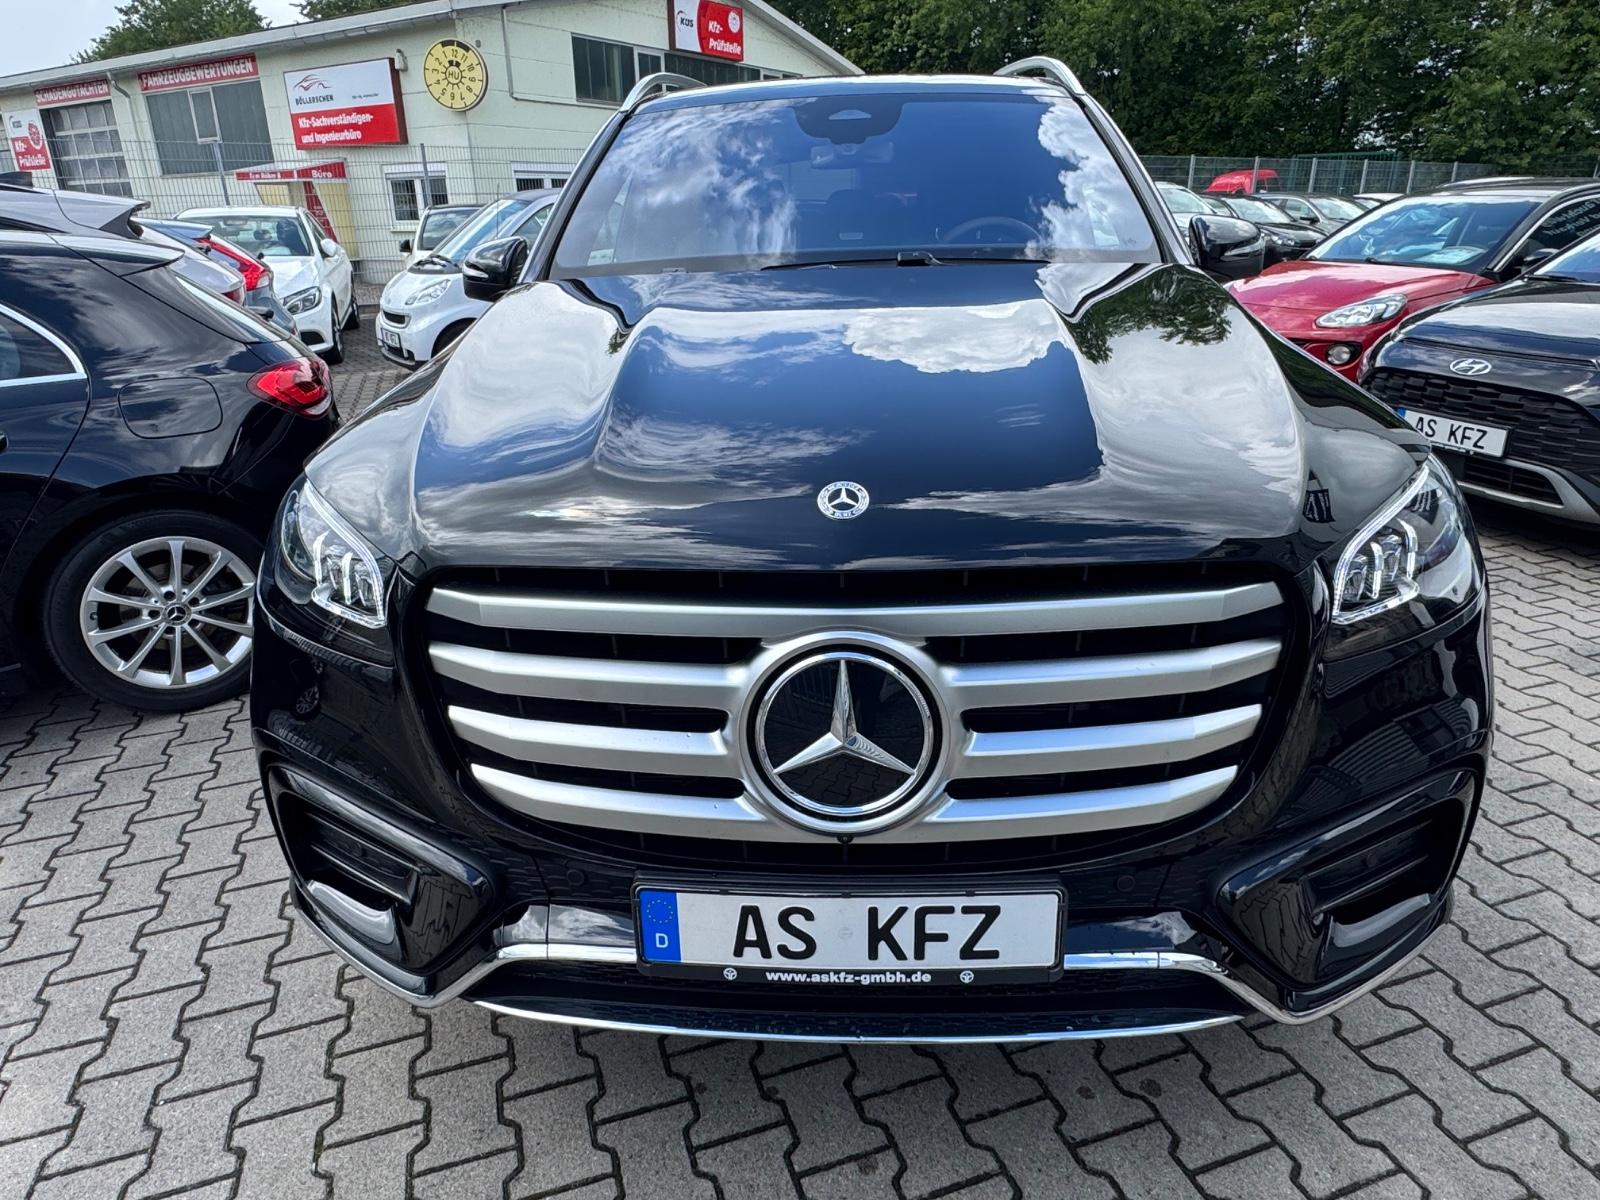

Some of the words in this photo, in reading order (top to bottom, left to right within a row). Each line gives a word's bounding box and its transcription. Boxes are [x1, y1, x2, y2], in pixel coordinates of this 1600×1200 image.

[708, 20, 723, 34] Kfz-
[709, 38, 741, 55] Prüfstelle
[142, 58, 253, 87] FAHRZEUGBEWERTUNGEN
[448, 70, 460, 80] HU
[35, 81, 109, 103] SCHADENGUTACHTEN
[298, 112, 373, 128] Kfz-Sachverständigen-
[301, 132, 315, 144] und
[315, 129, 362, 144] Ingenieurbüro
[1416, 416, 1437, 438] AS
[1447, 423, 1488, 449] KFZ
[655, 932, 668, 948] D
[733, 905, 817, 960] AS
[867, 905, 1001, 961] KFZ
[765, 971, 931, 985] www.askfz-gmbh.de
